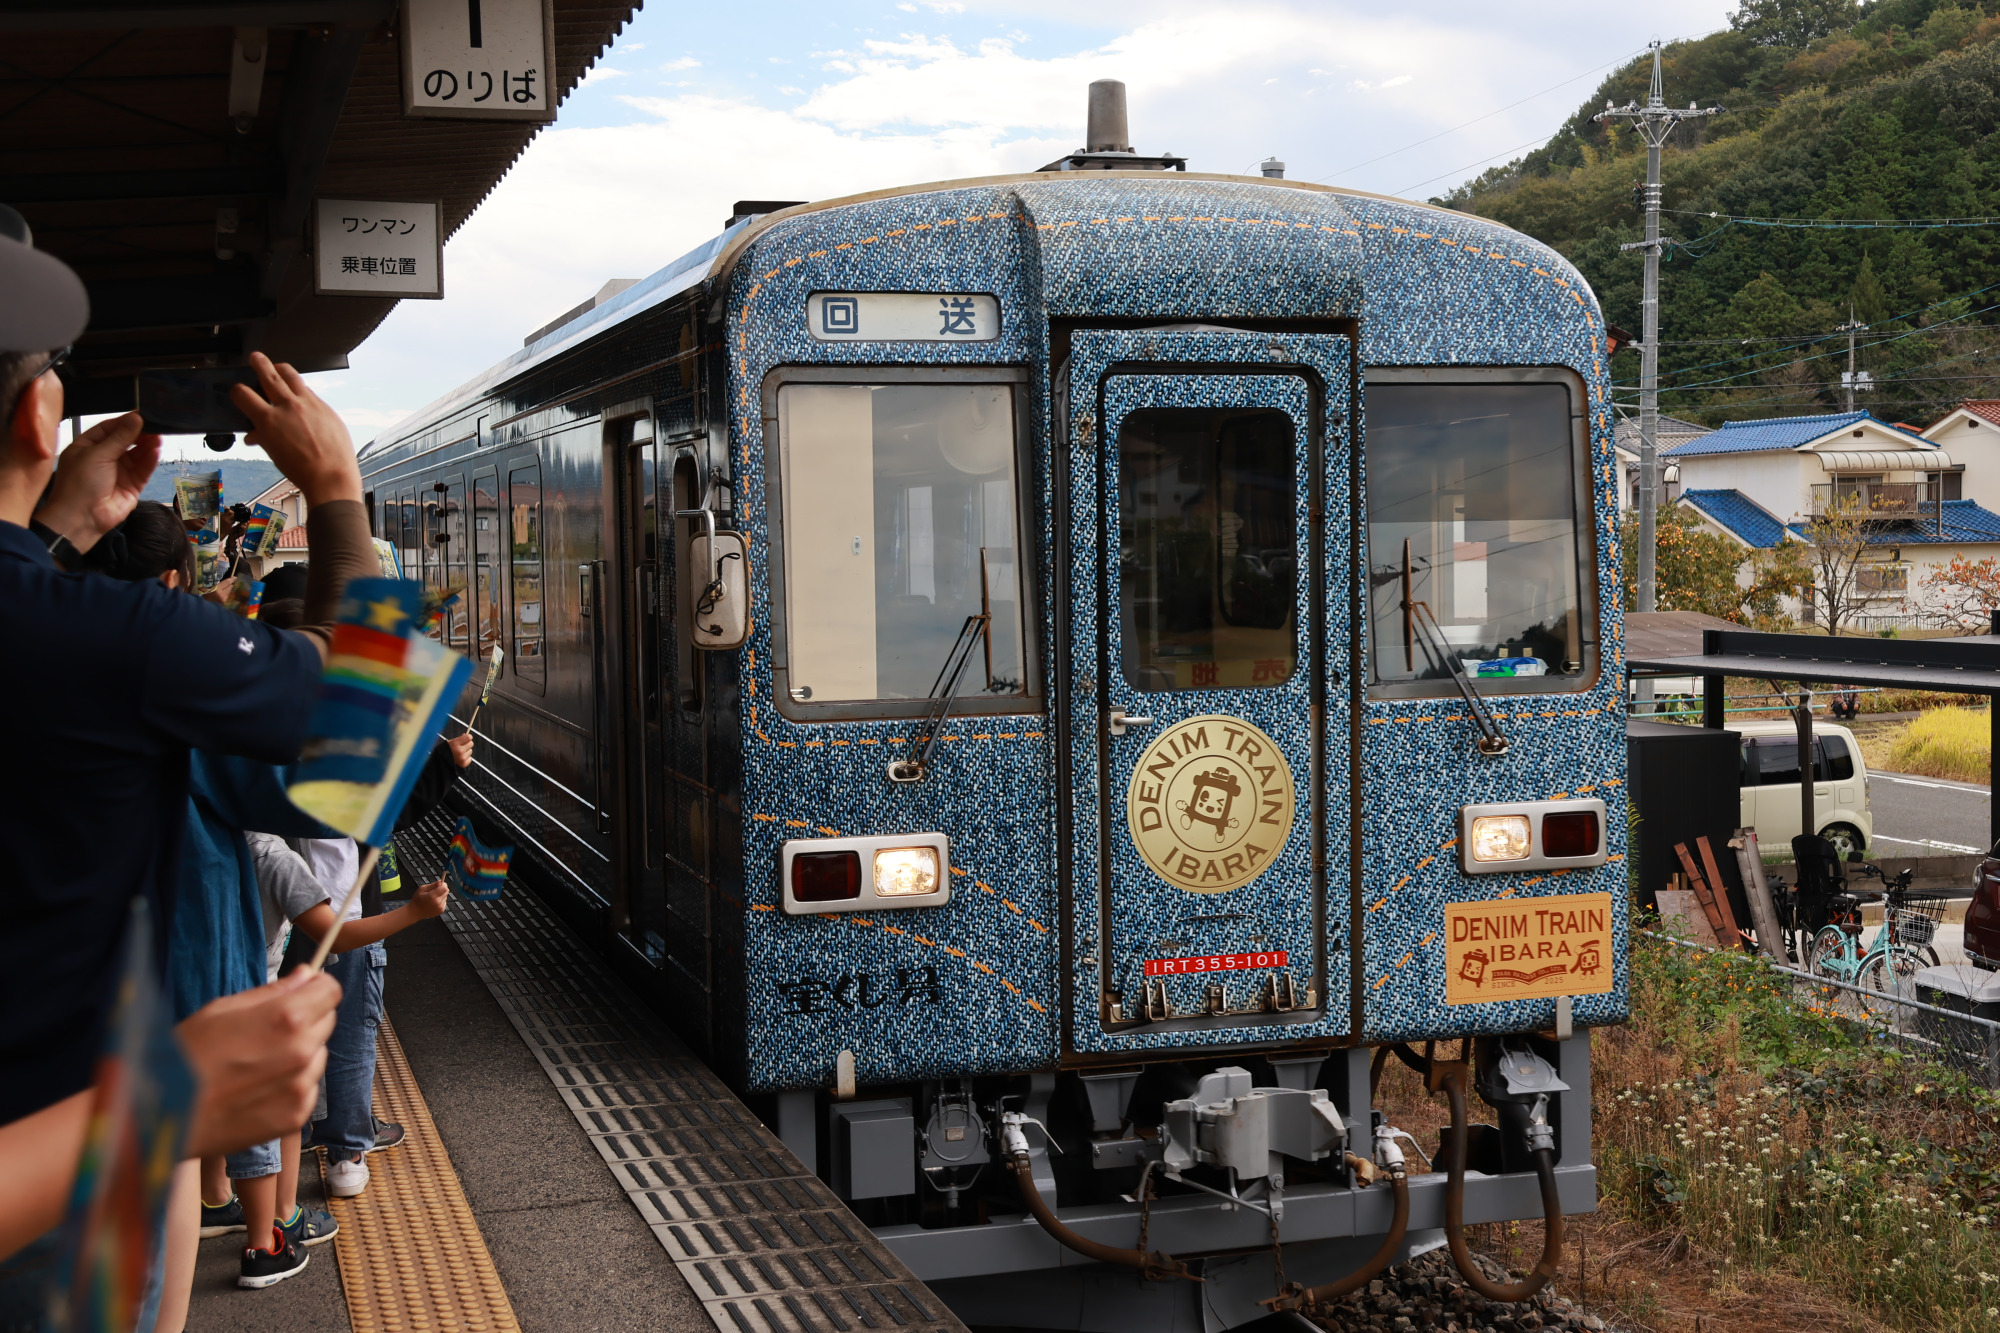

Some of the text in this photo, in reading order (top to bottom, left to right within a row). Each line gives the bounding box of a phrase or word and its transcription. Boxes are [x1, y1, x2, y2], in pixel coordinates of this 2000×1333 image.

[424, 69, 536, 103] のりば
[342, 217, 416, 235] ワンマン
[341, 256, 417, 275] 乗車位置
[1139, 726, 1283, 833] DENIM TRAIN
[1162, 842, 1269, 882] IBARA
[1452, 908, 1604, 943] DENIM TRAIN
[1490, 940, 1572, 963] IBARA
[1153, 954, 1279, 973] IRT355-101
[1491, 976, 1564, 989] SINCE 2025
